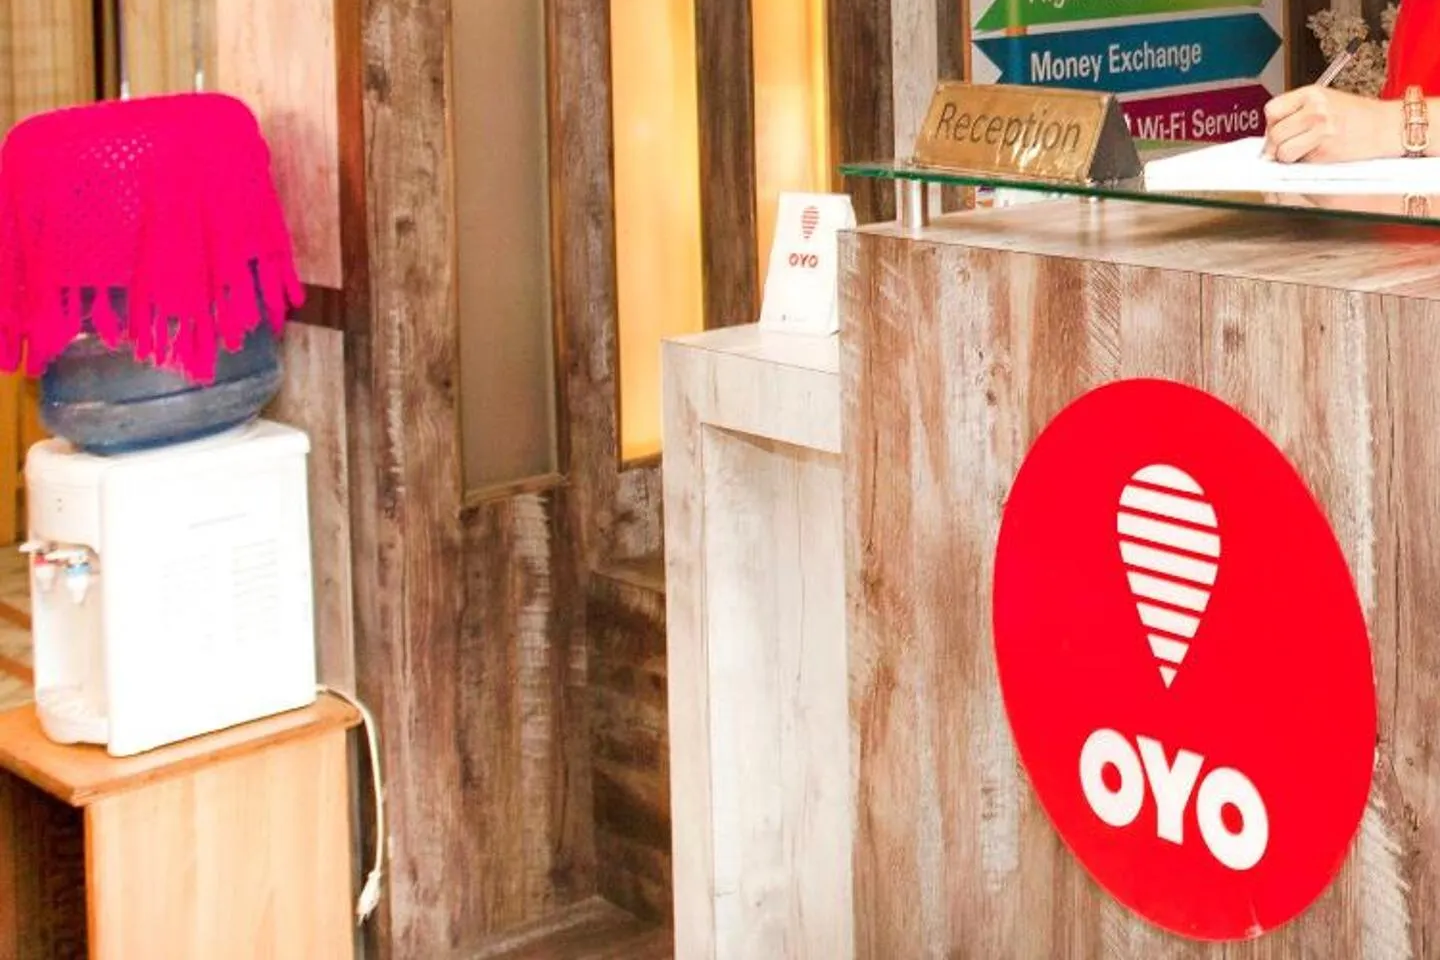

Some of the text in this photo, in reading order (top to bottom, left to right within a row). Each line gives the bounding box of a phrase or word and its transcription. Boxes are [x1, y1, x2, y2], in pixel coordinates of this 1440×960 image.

[1031, 41, 1202, 82] Money Exchange
[934, 102, 1082, 154] Reception
[1137, 111, 1187, 141] Wi-Fi
[1192, 104, 1259, 138] Service
[788, 252, 819, 268] OYO
[1079, 727, 1269, 871] OYO
